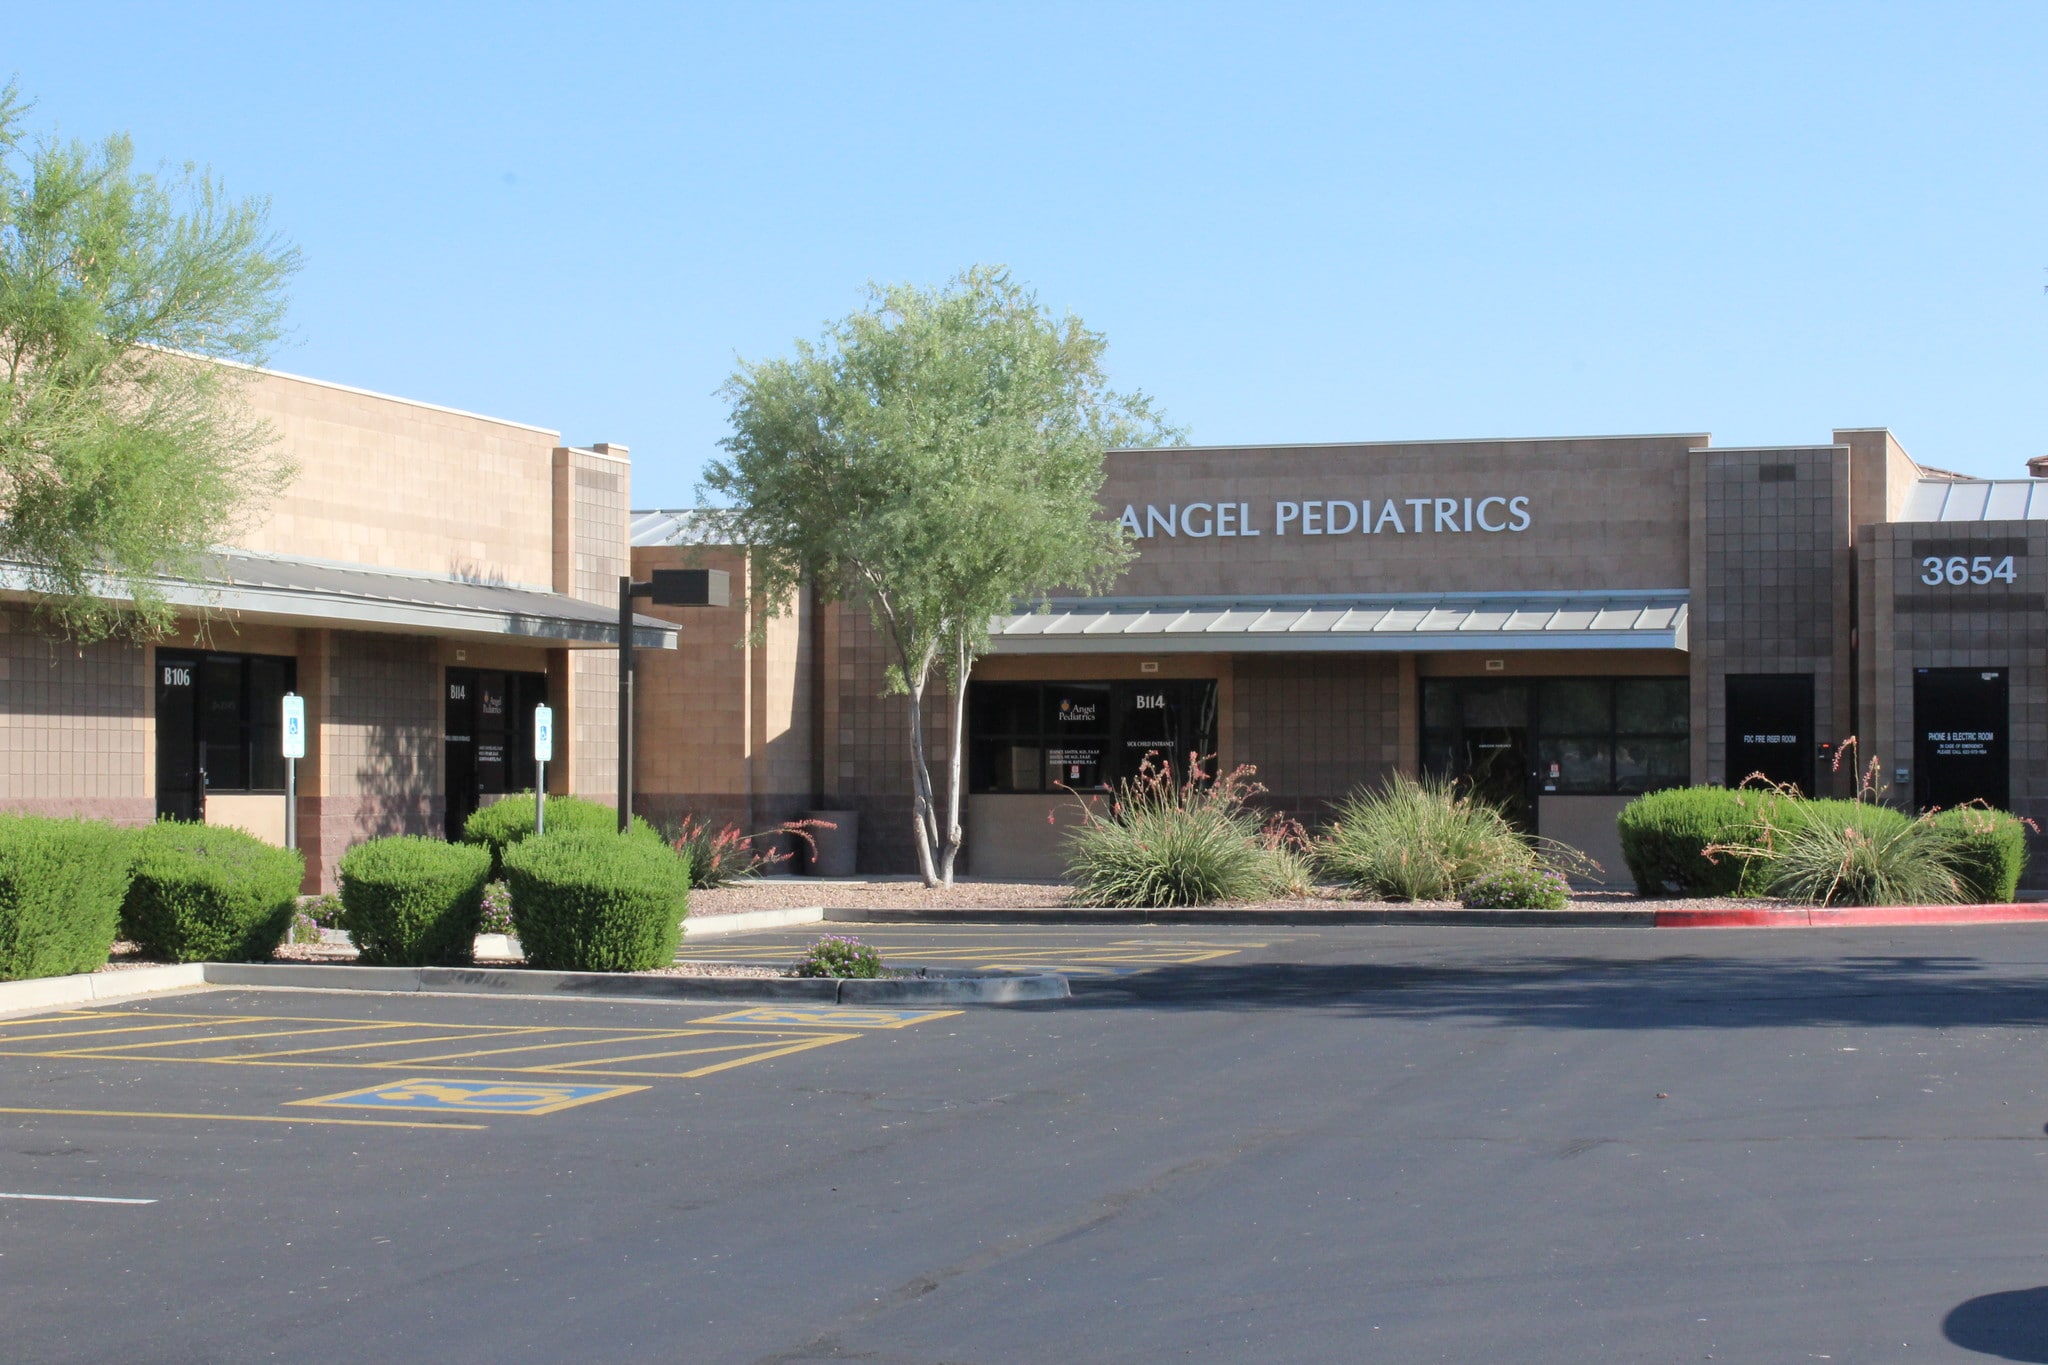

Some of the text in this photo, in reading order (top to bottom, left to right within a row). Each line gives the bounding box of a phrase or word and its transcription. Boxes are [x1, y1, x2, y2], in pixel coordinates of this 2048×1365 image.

[1121, 496, 1531, 539] ANGEL PEDIATRICS
[1921, 555, 2017, 586] 3654
[164, 667, 190, 686] B106
[450, 684, 466, 700] B114
[1072, 704, 1095, 714] Angel
[1136, 695, 1165, 709] B114
[1059, 712, 1096, 720] Pediatrics
[1743, 735, 1797, 743] FDC FIRE RISER ROOM
[1928, 732, 1993, 741] PHONE & ELECTRIC ROOM
